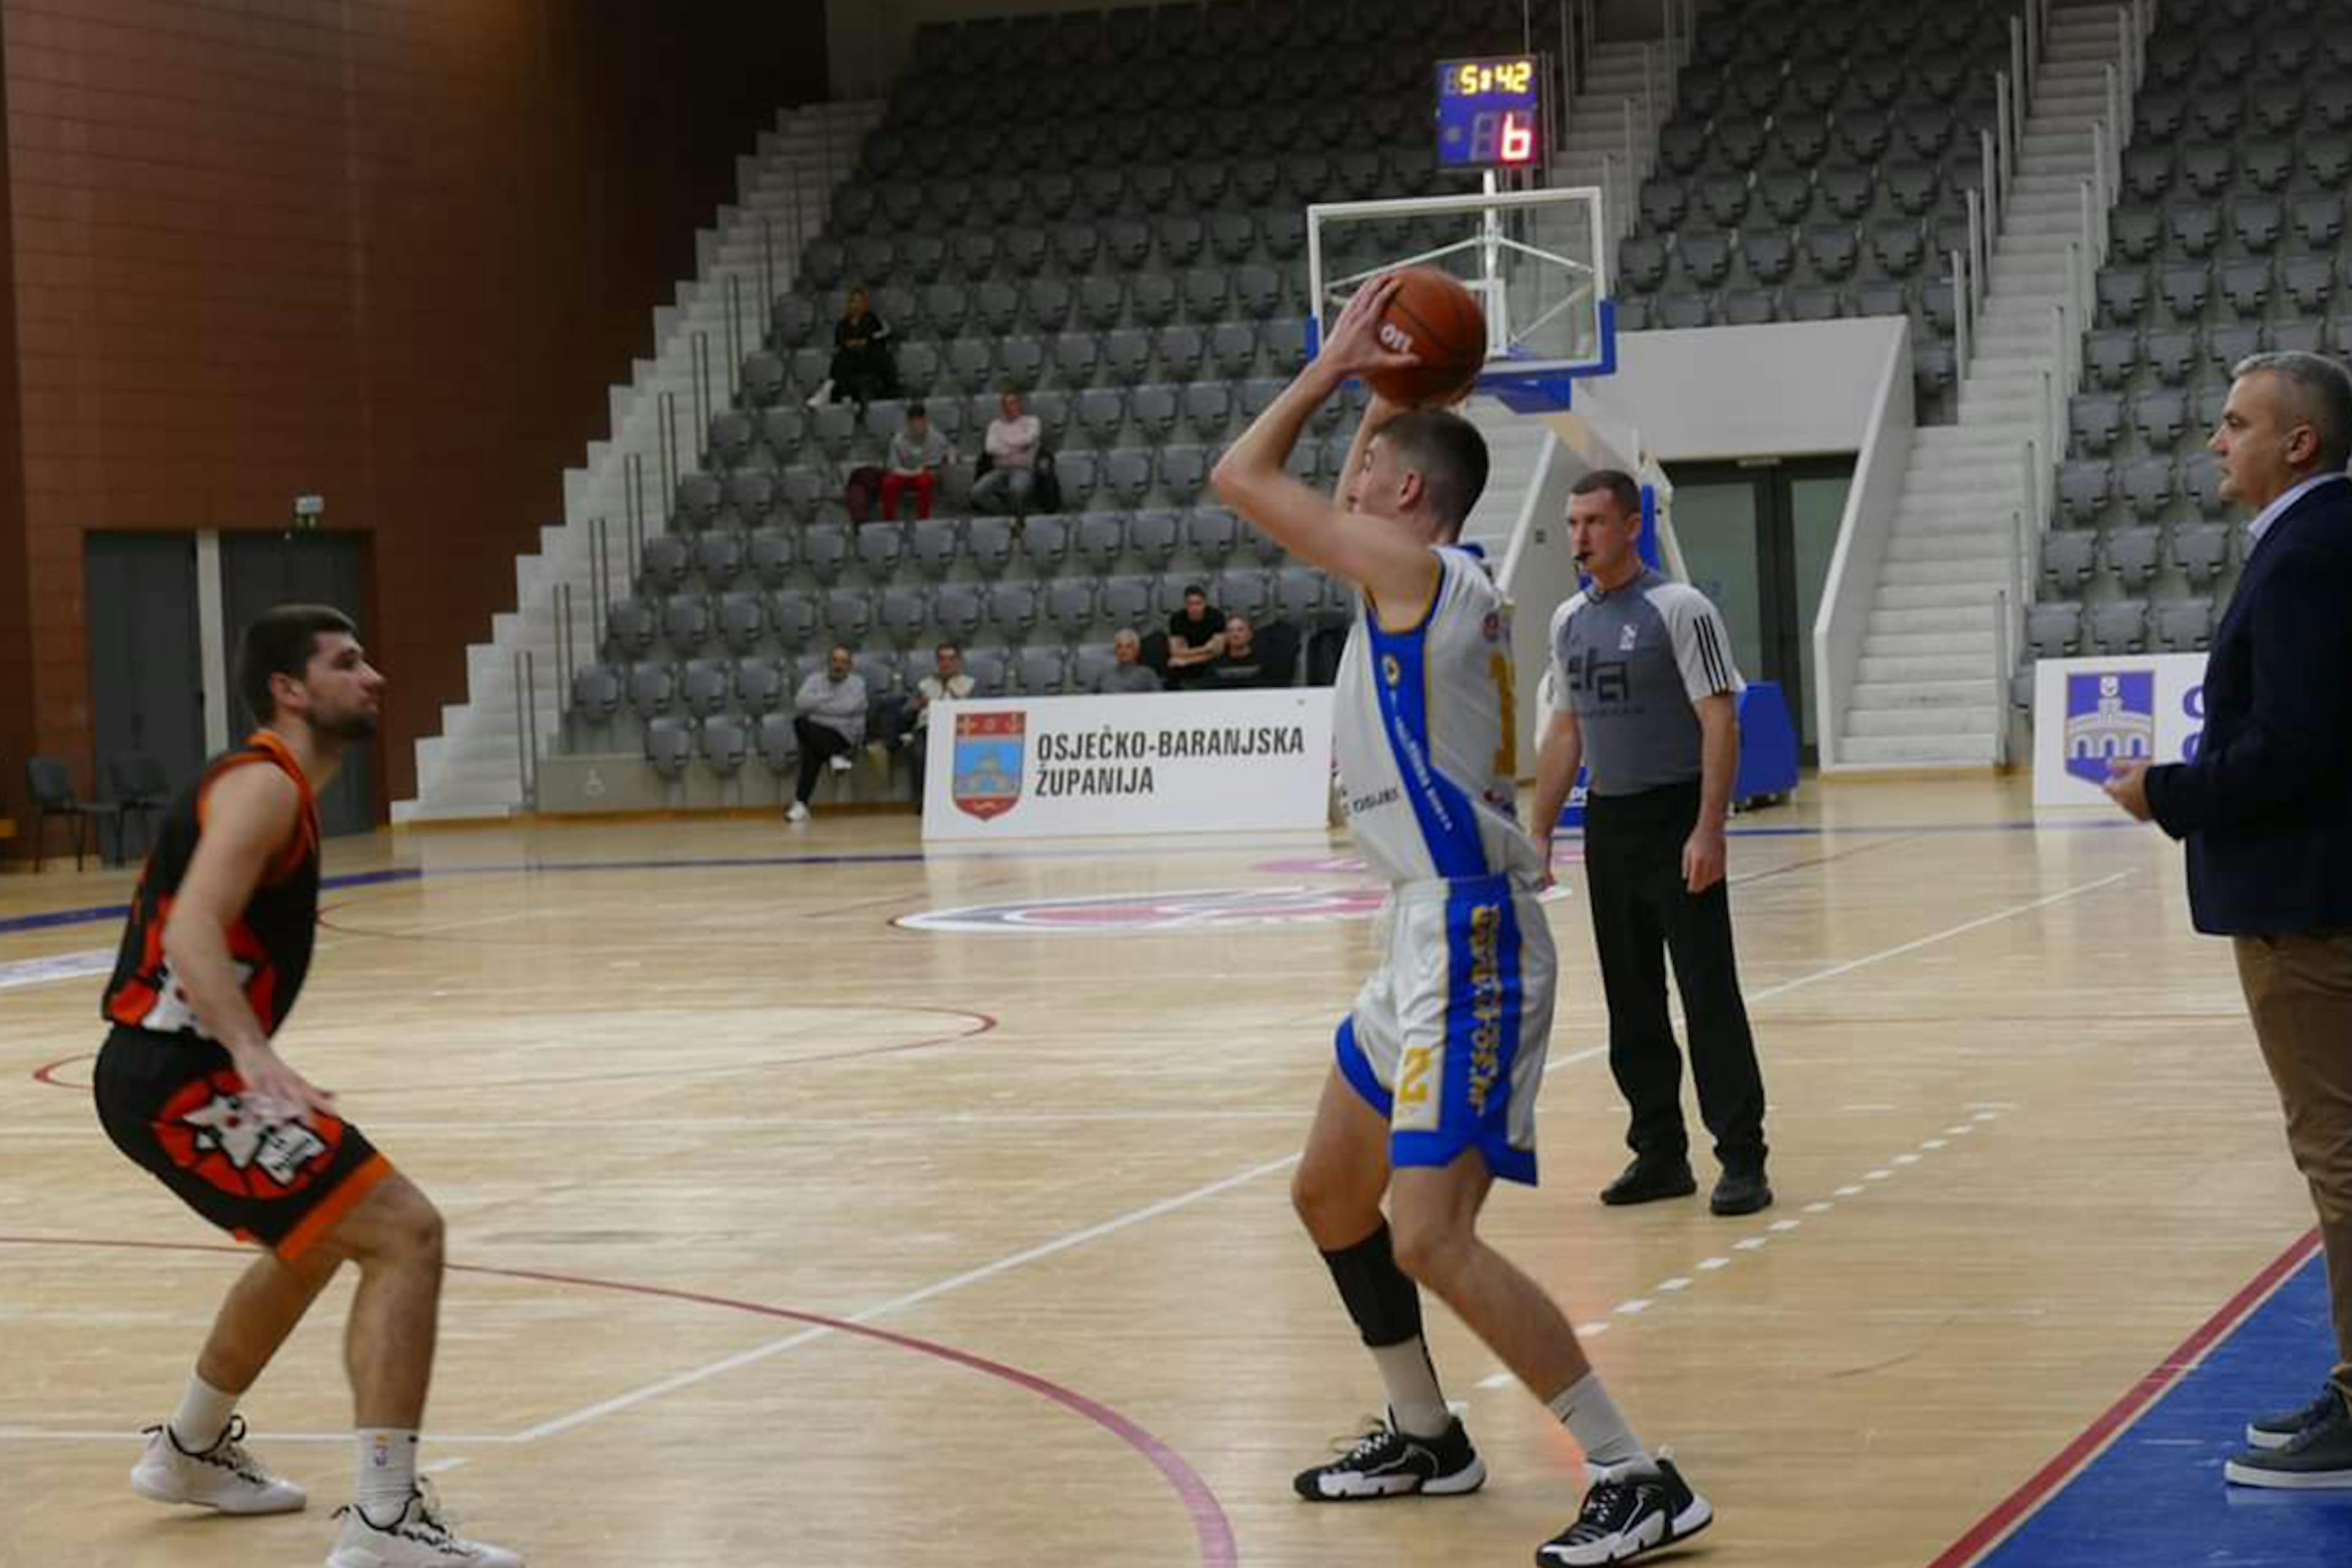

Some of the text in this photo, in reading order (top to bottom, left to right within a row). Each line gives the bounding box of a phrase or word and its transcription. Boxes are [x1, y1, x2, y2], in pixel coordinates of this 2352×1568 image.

[1459, 61, 1531, 95] 5:42
[1037, 724, 1305, 761] OSJEČKO-BARANJSKA
[1035, 764, 1154, 796] ŽUPANIJA
